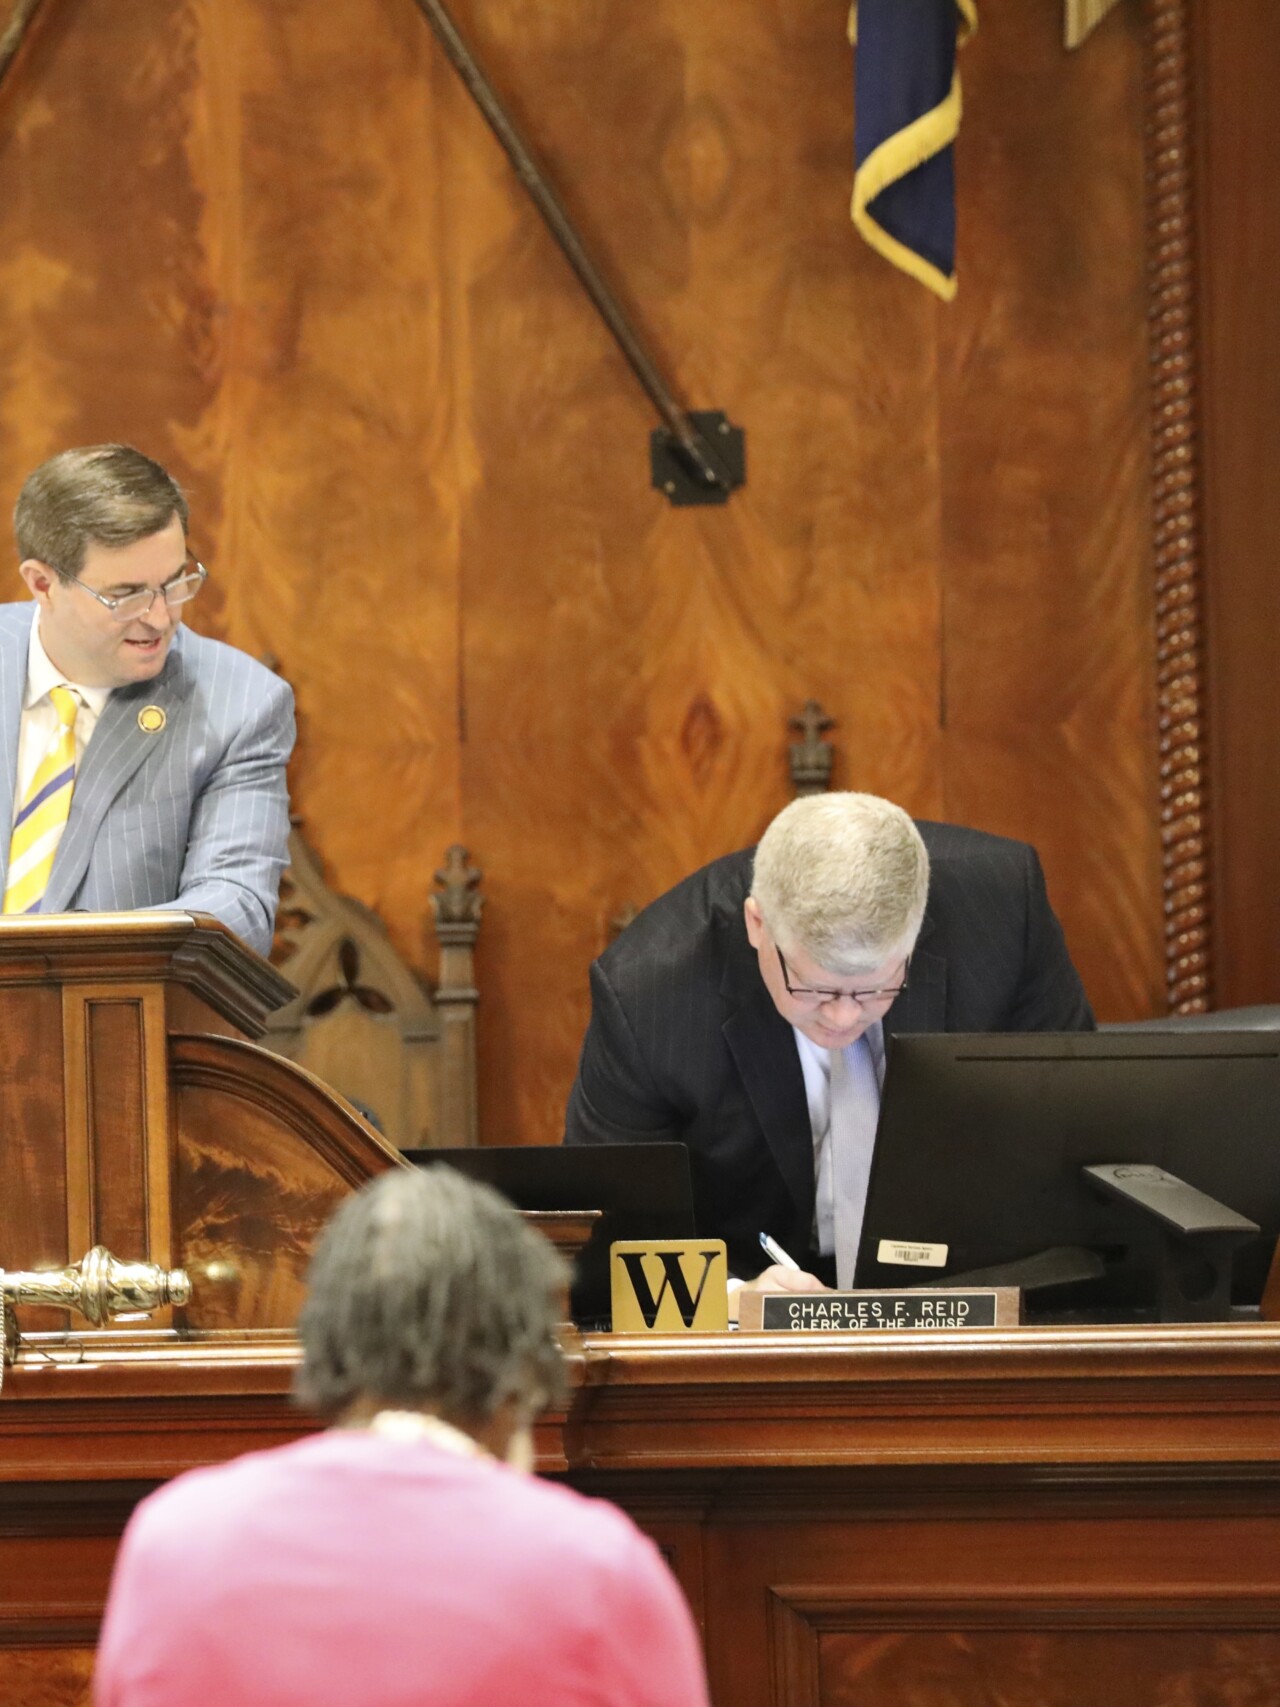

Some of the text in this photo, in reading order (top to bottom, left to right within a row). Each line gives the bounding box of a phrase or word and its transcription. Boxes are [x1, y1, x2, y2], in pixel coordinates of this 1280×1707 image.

[616, 1250, 721, 1329] W
[788, 1300, 970, 1318] CHARLES F. REID
[790, 1317, 966, 1330] CLERK OF THE HOUSE
